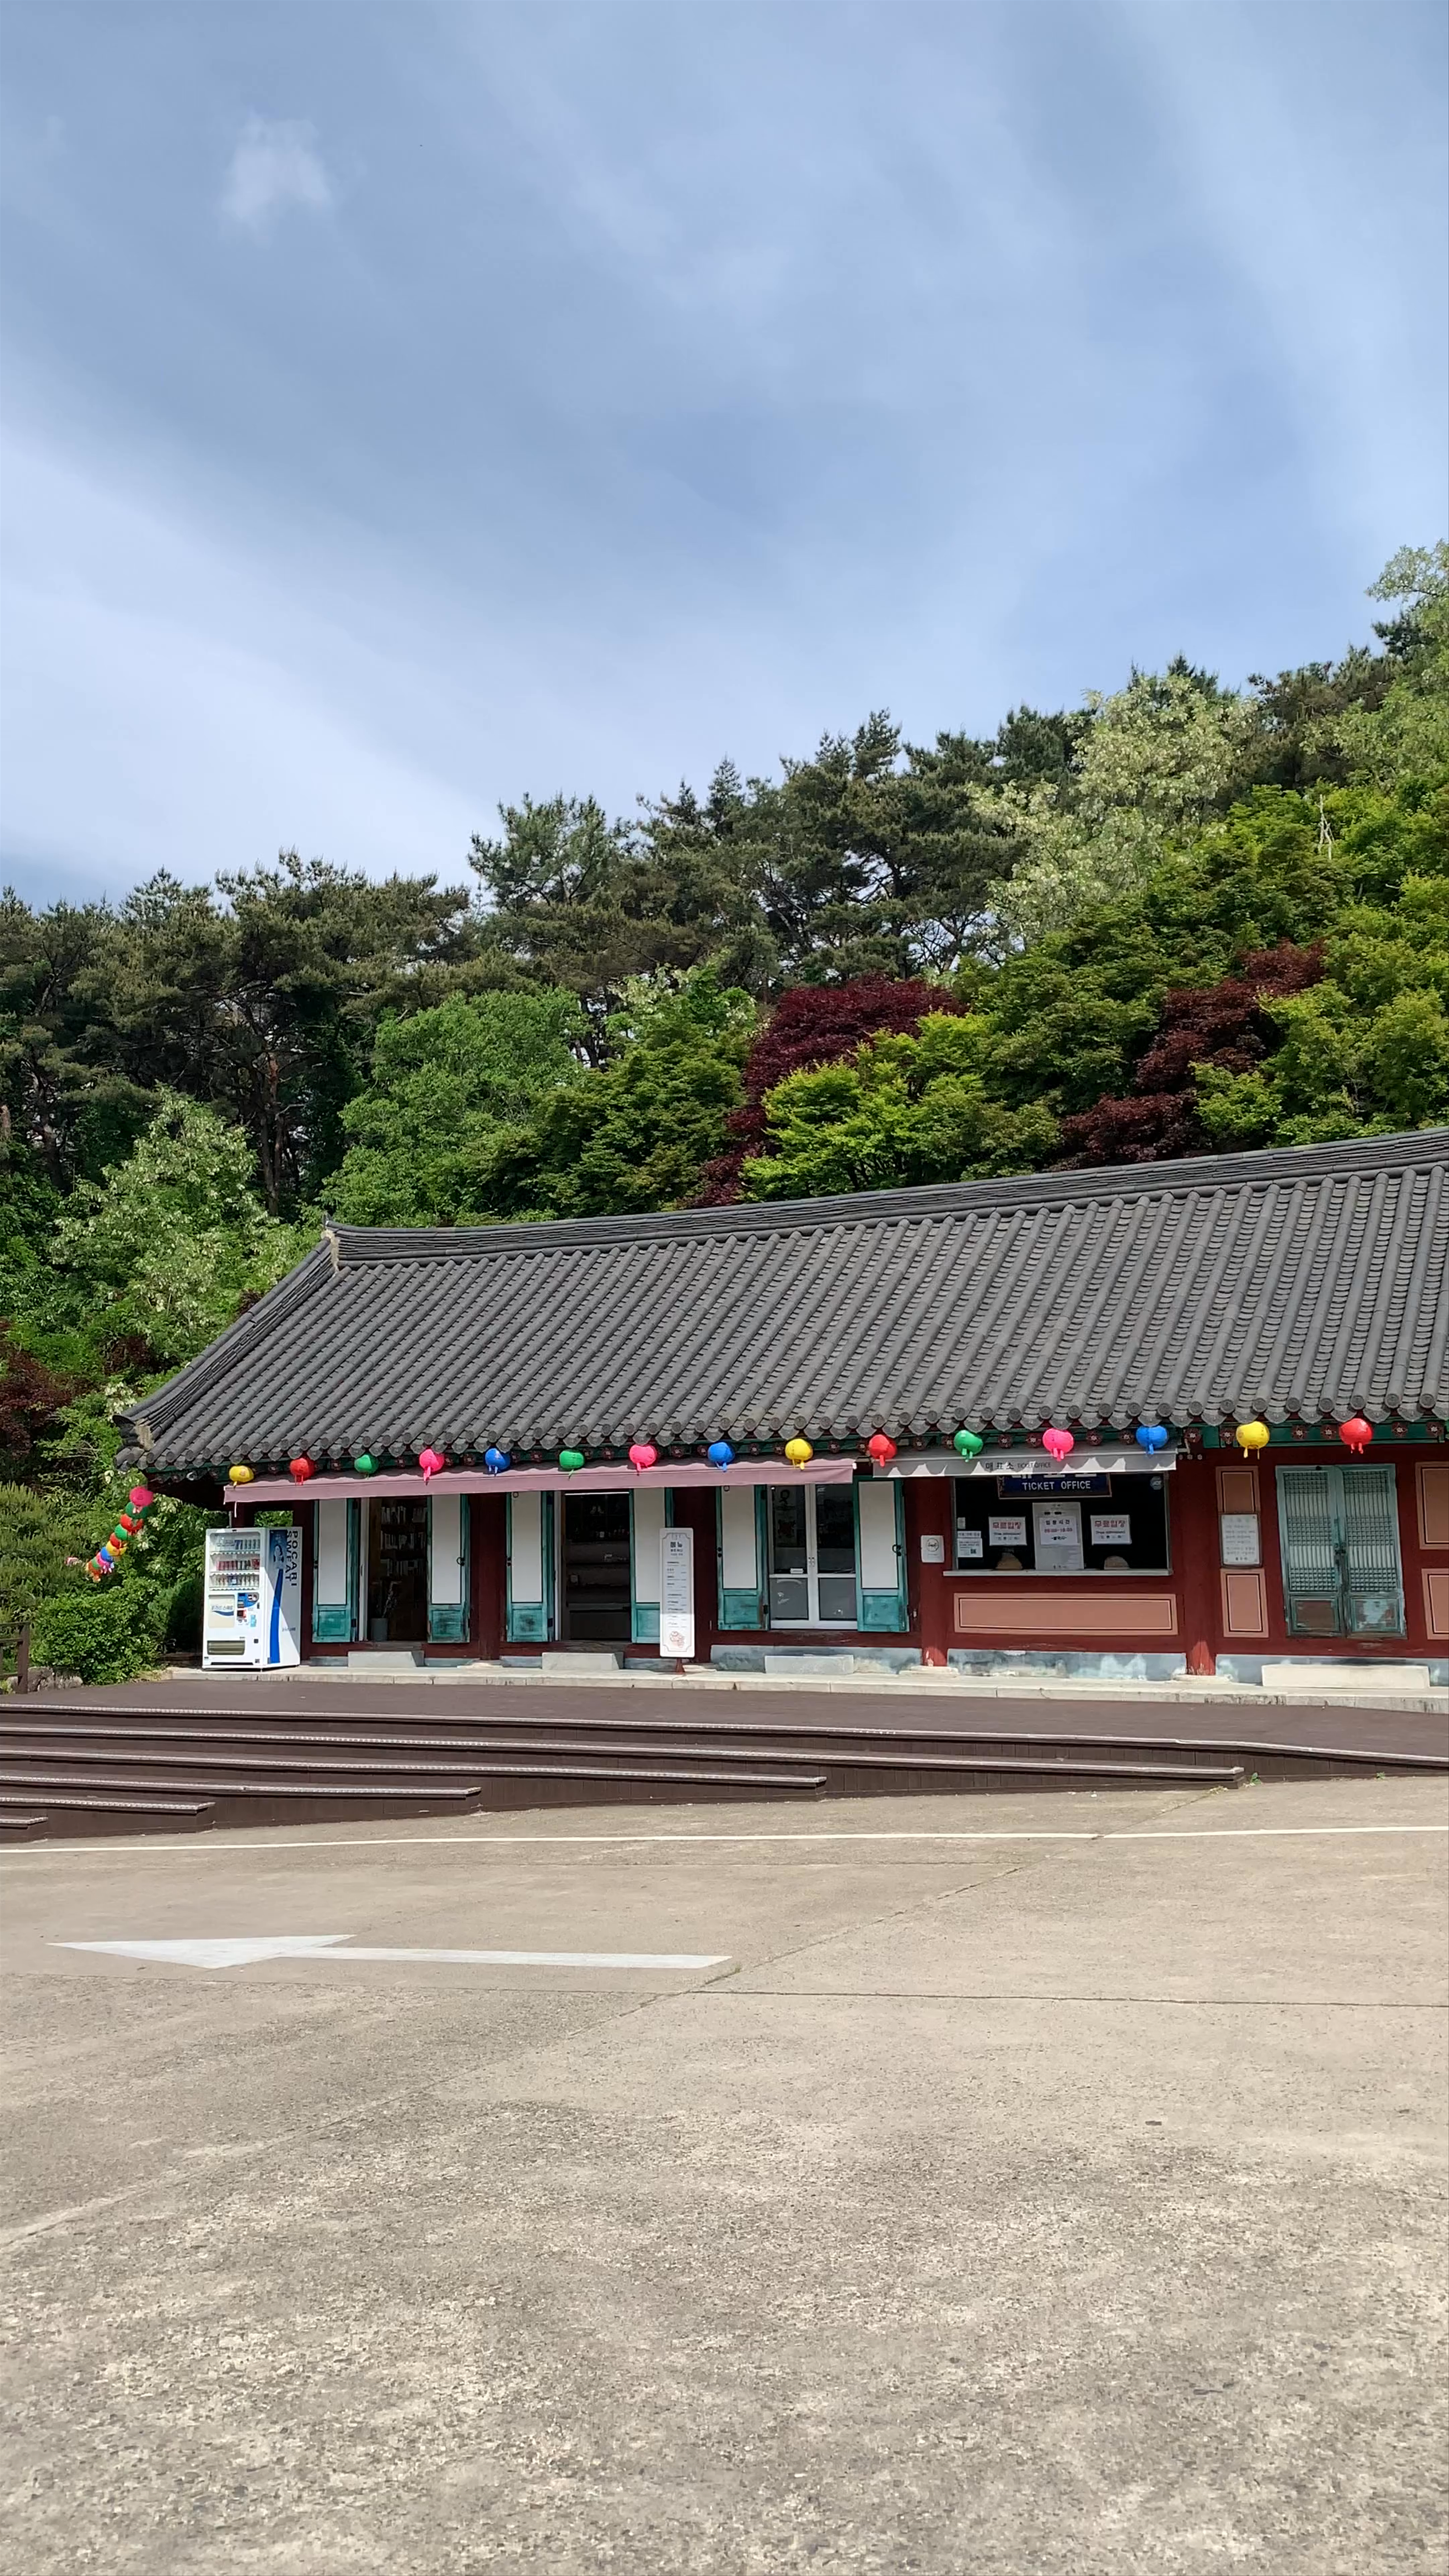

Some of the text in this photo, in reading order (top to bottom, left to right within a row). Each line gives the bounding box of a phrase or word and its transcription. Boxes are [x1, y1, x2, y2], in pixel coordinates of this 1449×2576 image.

[986, 1462, 1014, 1470] 매표소
[1022, 1481, 1091, 1490] TICKET OFFICE
